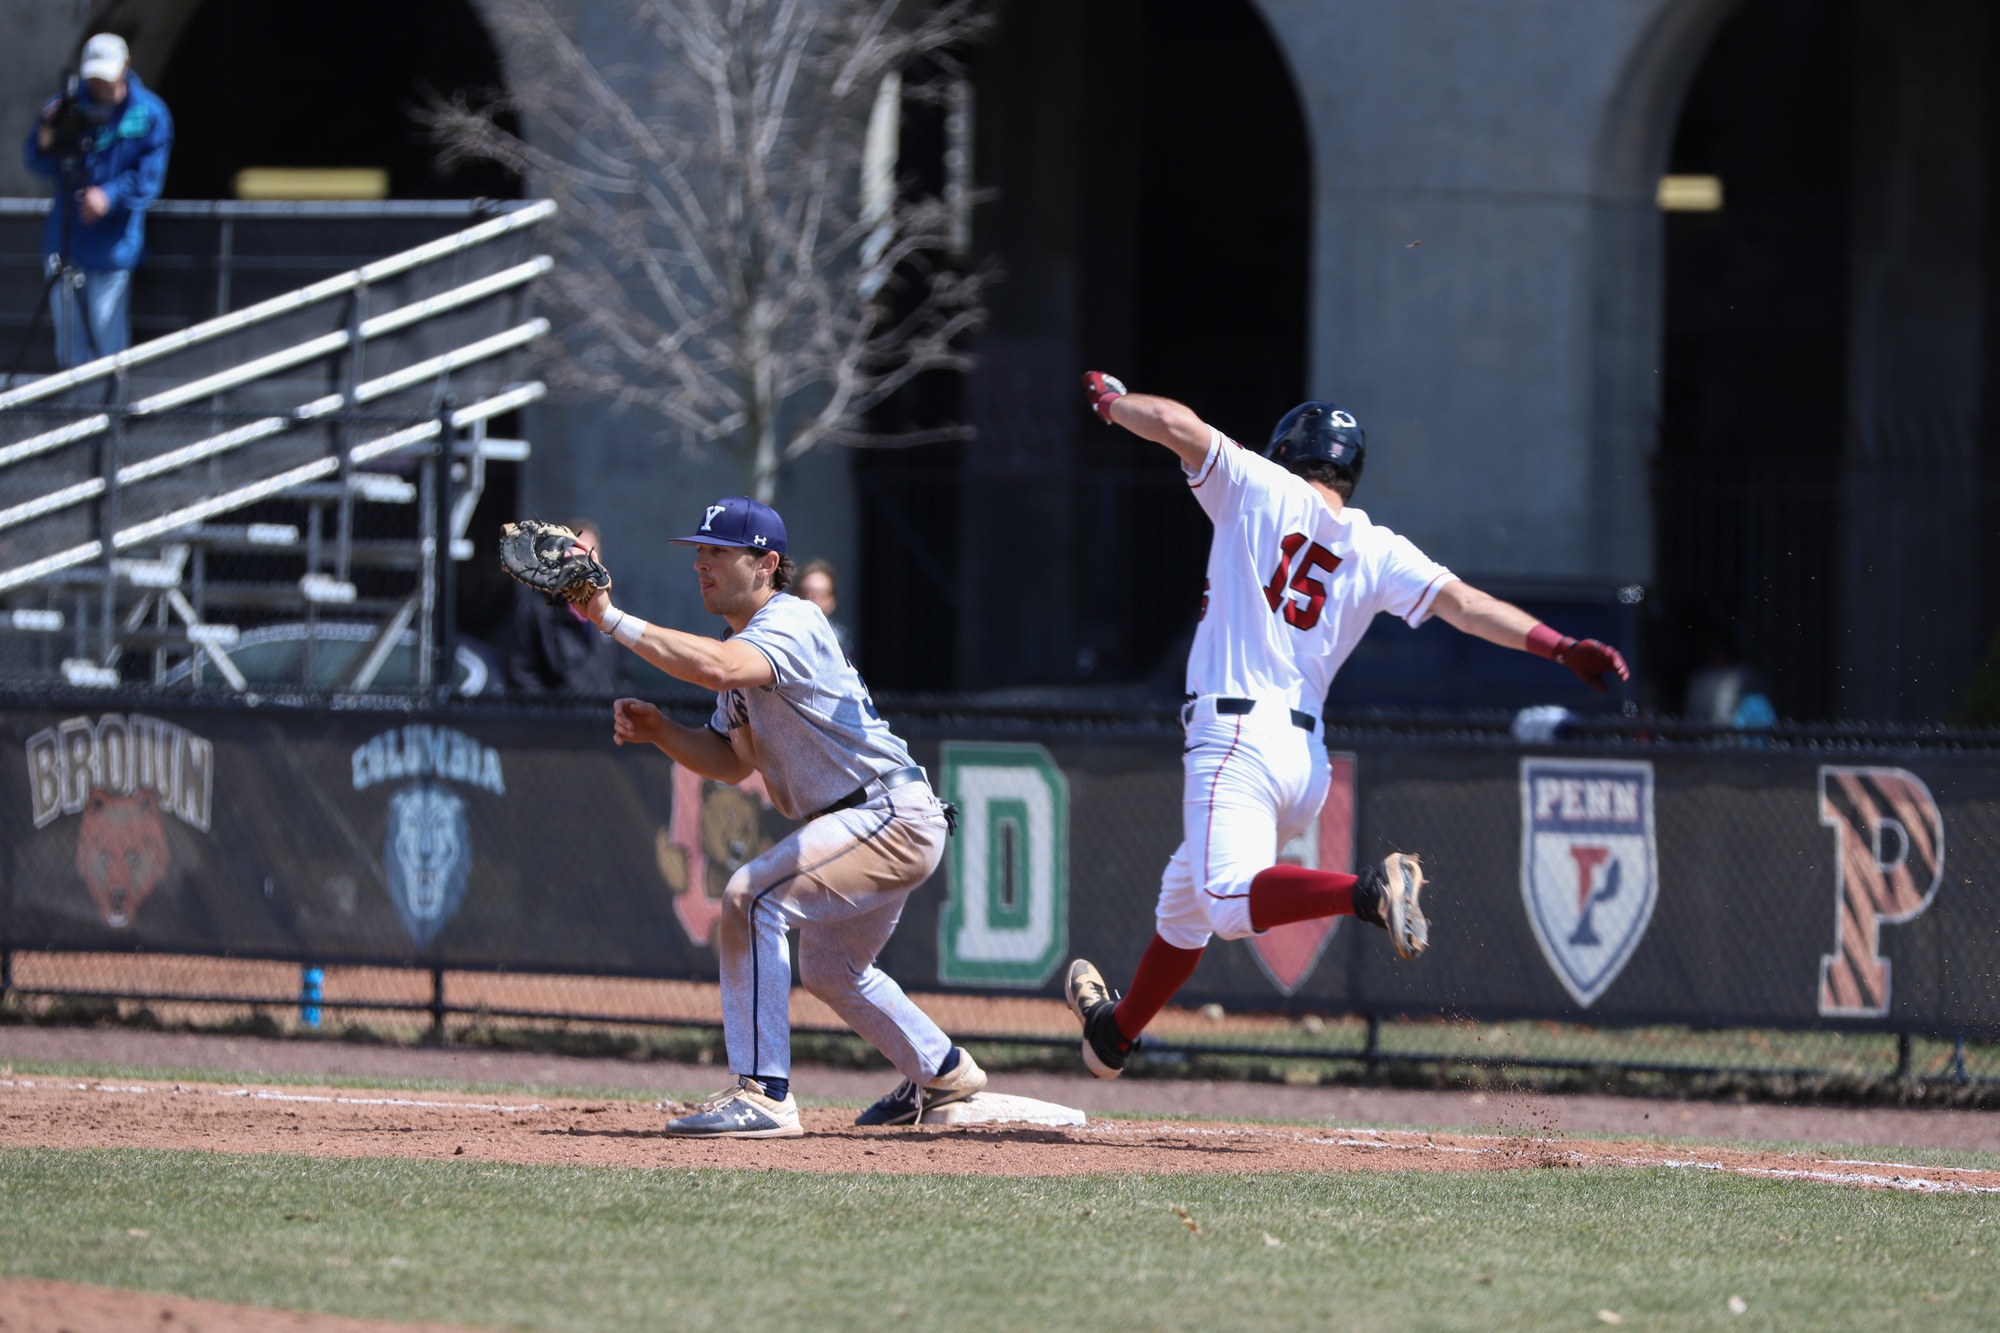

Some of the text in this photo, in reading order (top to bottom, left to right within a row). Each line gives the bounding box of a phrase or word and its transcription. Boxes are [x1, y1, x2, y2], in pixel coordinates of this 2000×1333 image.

[700, 505, 726, 531] Y
[1263, 532, 1343, 632] 15
[26, 713, 213, 834] BROWN
[351, 723, 506, 796] COLUMBIA
[1535, 777, 1640, 823] PENN
[938, 740, 1070, 989] D
[1568, 844, 1621, 946] P
[1818, 765, 1945, 1018] P
